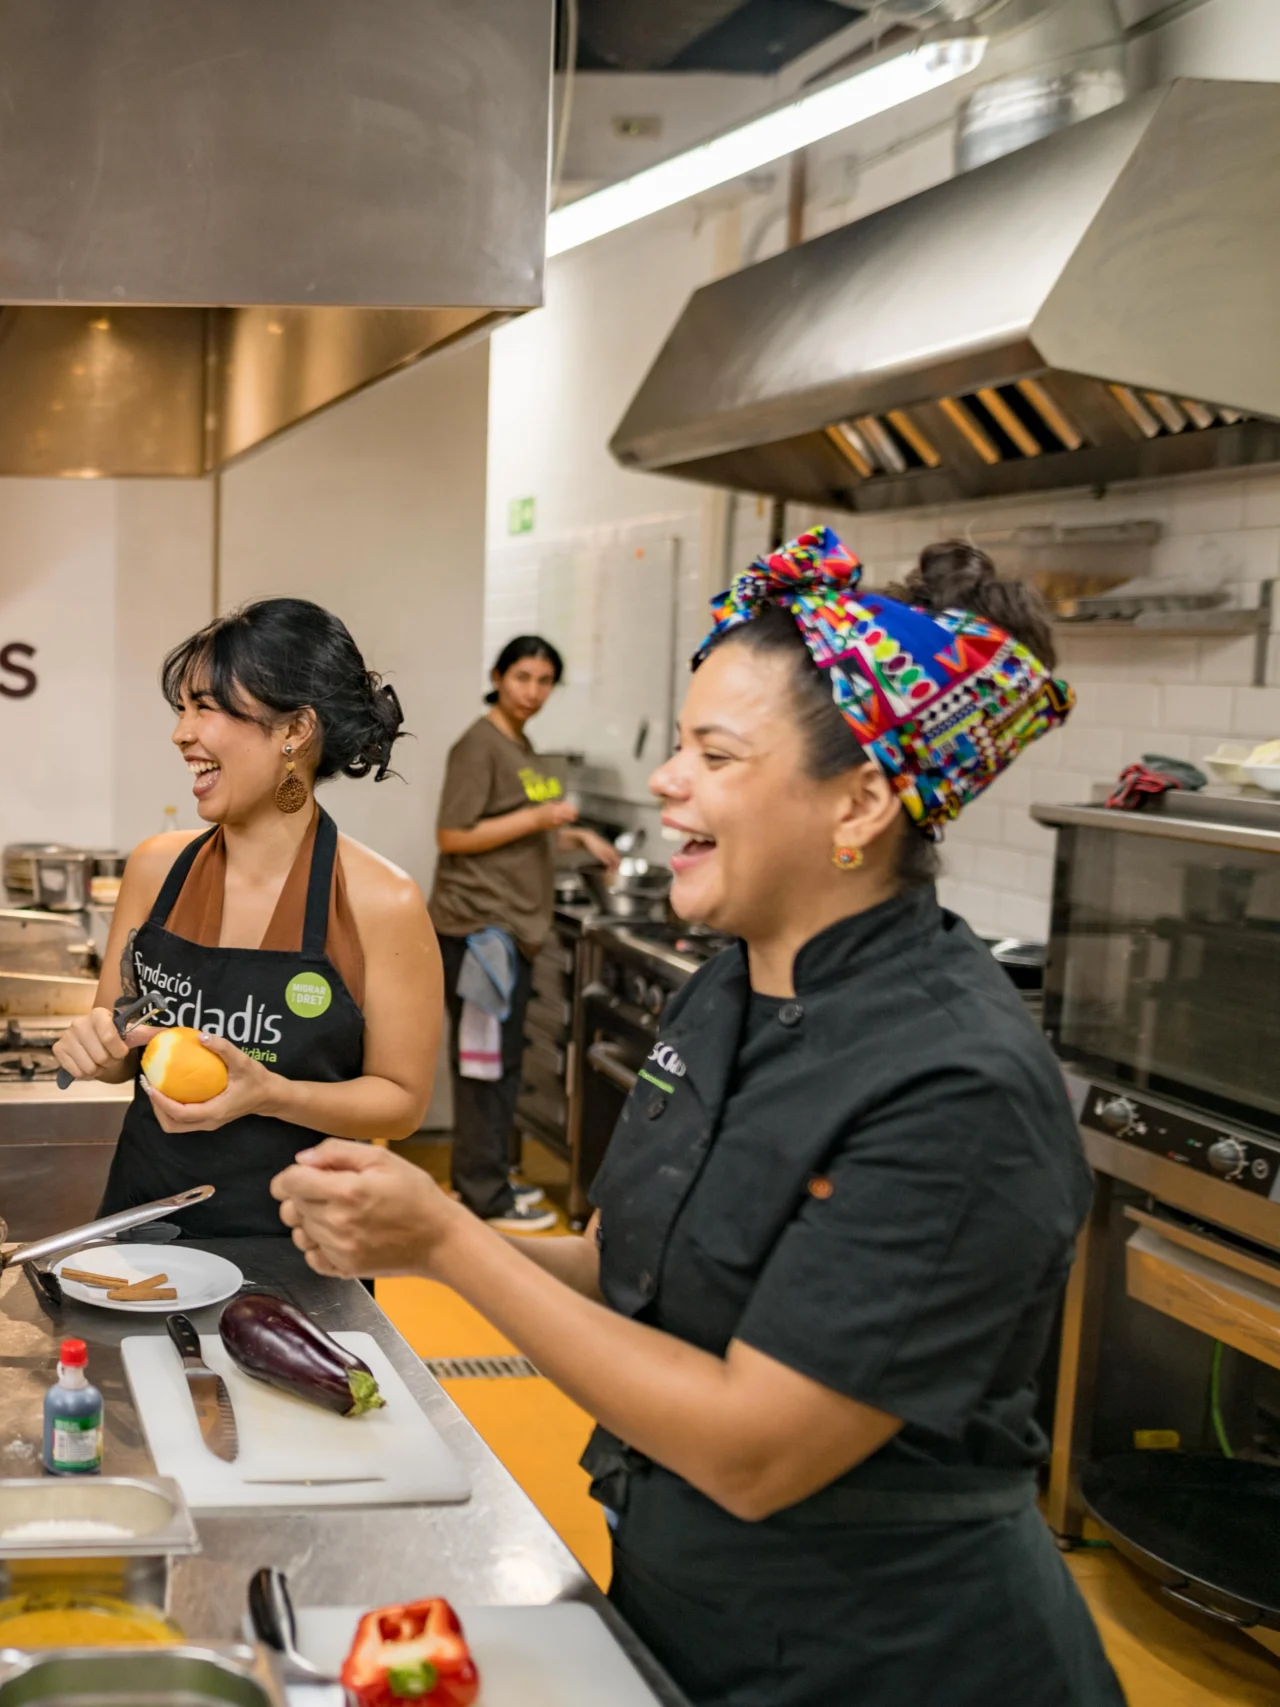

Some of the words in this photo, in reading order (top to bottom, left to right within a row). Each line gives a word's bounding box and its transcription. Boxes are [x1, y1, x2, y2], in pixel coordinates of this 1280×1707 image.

[133, 951, 192, 997] fndació
[292, 983, 326, 995] MIGRAR
[296, 993, 324, 1005] DRET
